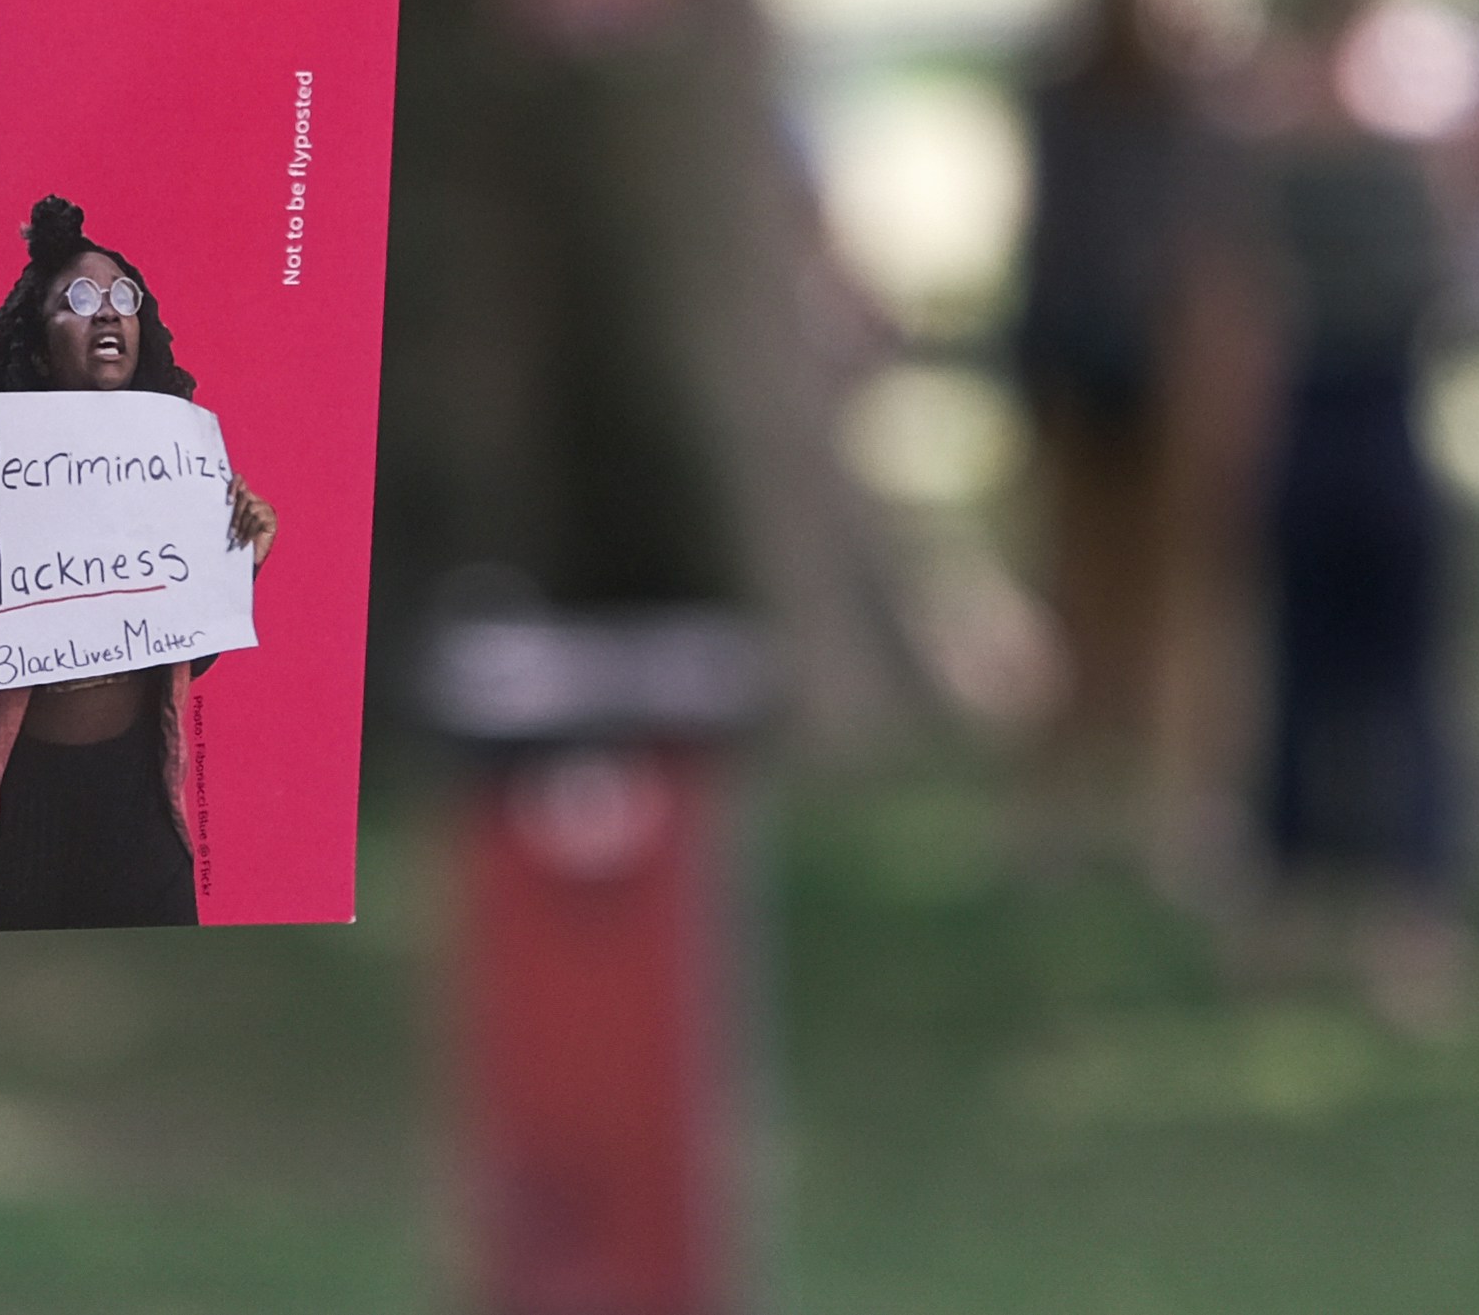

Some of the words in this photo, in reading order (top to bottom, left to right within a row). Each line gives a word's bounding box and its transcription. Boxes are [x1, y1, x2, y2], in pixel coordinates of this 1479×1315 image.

[286, 70, 314, 177] flyposted
[285, 182, 306, 211] be
[285, 216, 305, 240] to
[282, 244, 302, 286] Not
